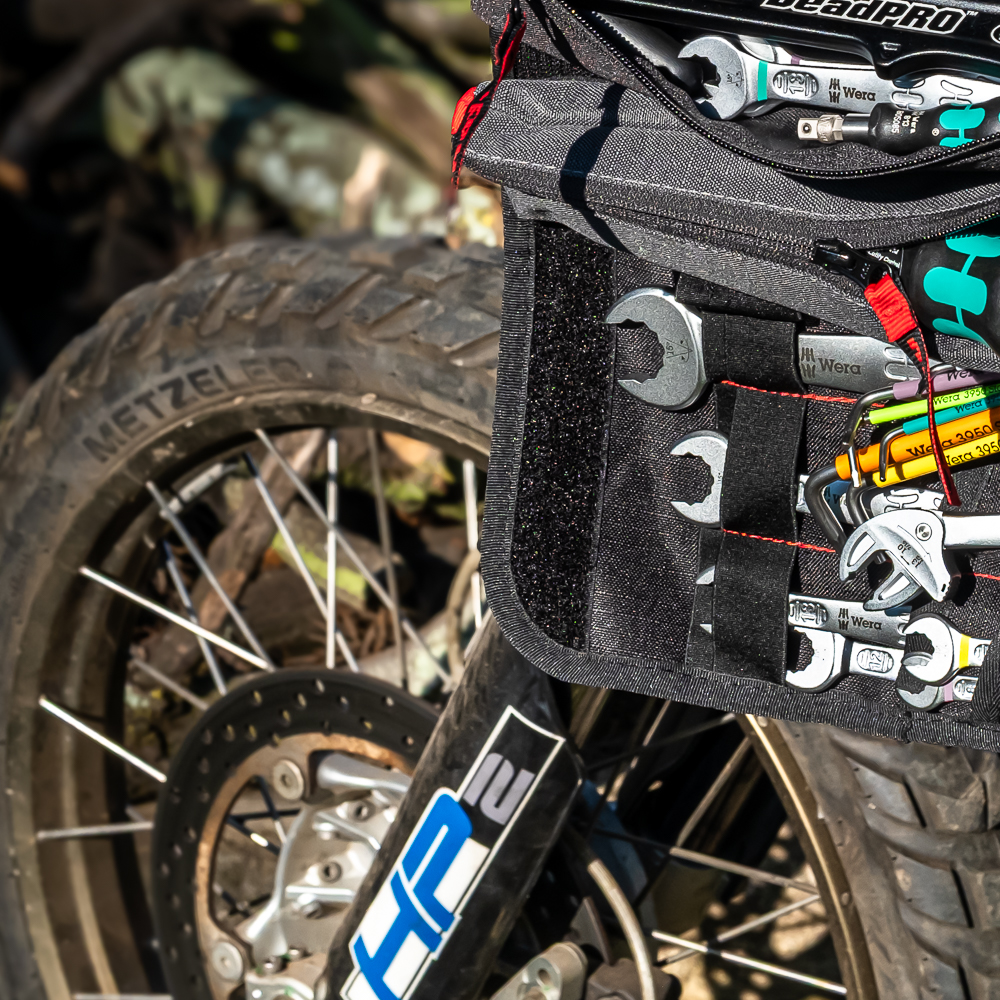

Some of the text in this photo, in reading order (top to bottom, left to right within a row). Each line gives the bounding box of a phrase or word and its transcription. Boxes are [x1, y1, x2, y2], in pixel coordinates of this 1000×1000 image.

[843, 86, 876, 103] Wera
[910, 115, 920, 134] Wera
[818, 358, 862, 376] Wera
[933, 393, 960, 406] Wera
[955, 399, 982, 414] Wera
[956, 424, 995, 442] 3950
[850, 615, 883, 631] Wera
